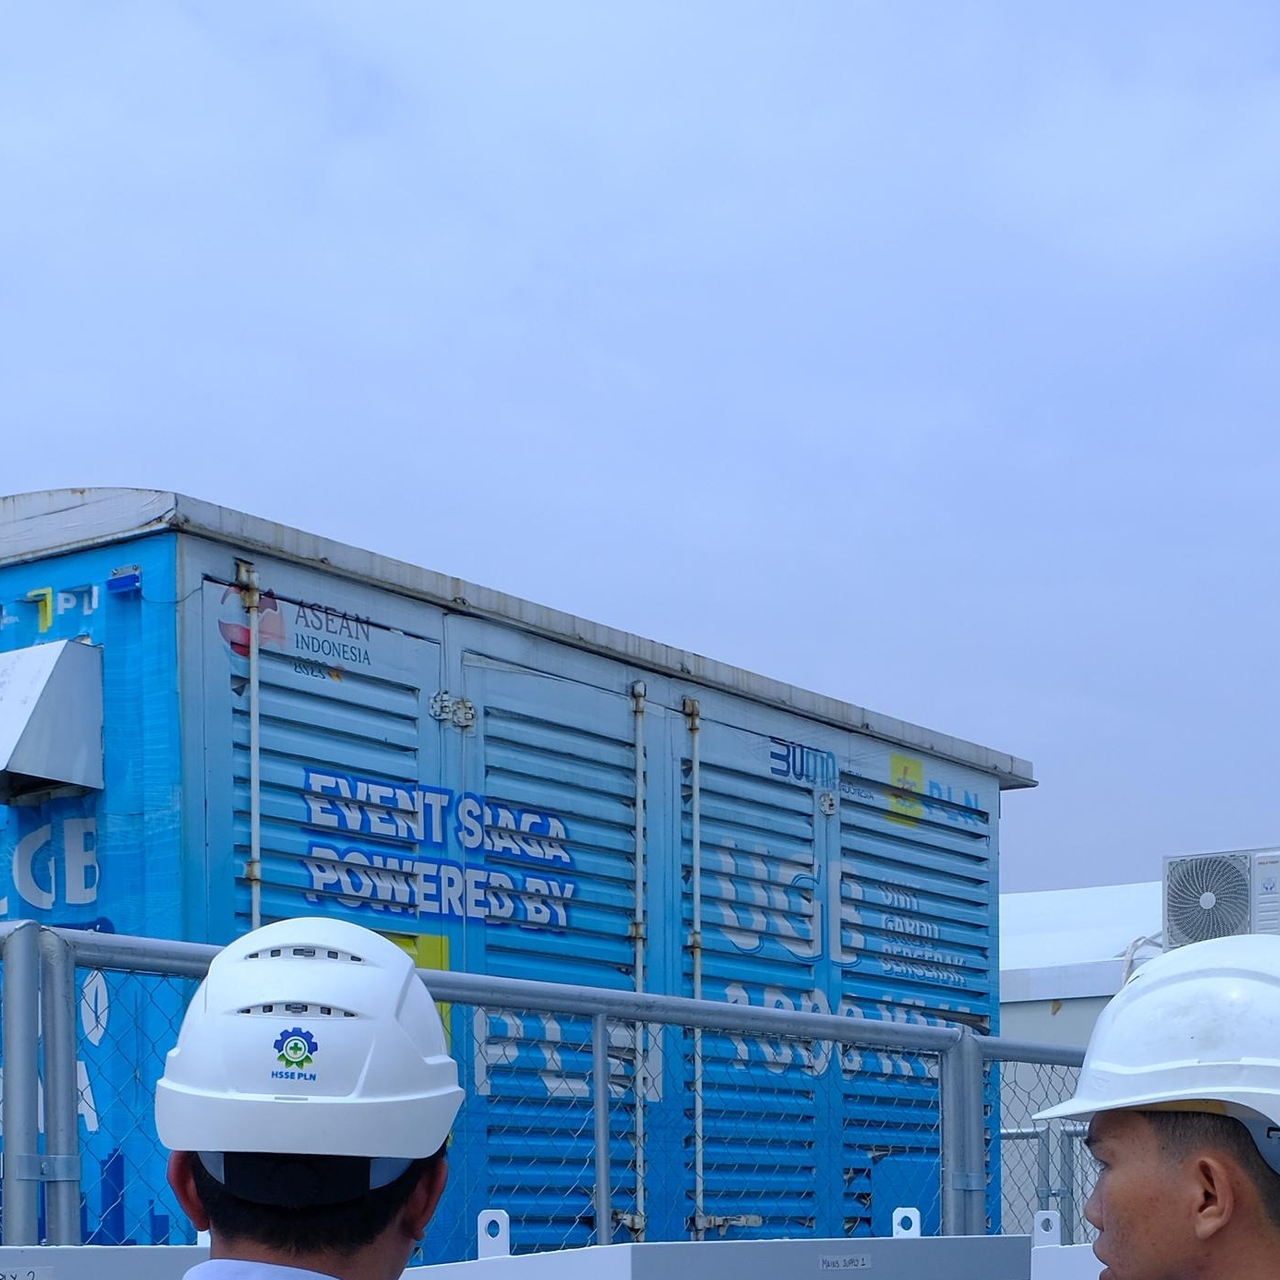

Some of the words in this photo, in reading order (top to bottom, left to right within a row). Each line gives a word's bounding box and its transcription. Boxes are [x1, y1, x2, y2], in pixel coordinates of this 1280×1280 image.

[295, 601, 371, 642] ASEAN
[295, 633, 371, 665] INDONESIA
[307, 772, 448, 844] EVENT
[457, 797, 570, 863] SIAGA
[308, 847, 514, 925] POWERED
[517, 879, 575, 932] BY
[271, 1070, 296, 1081] HSSE
[297, 1072, 317, 1082] PLN
